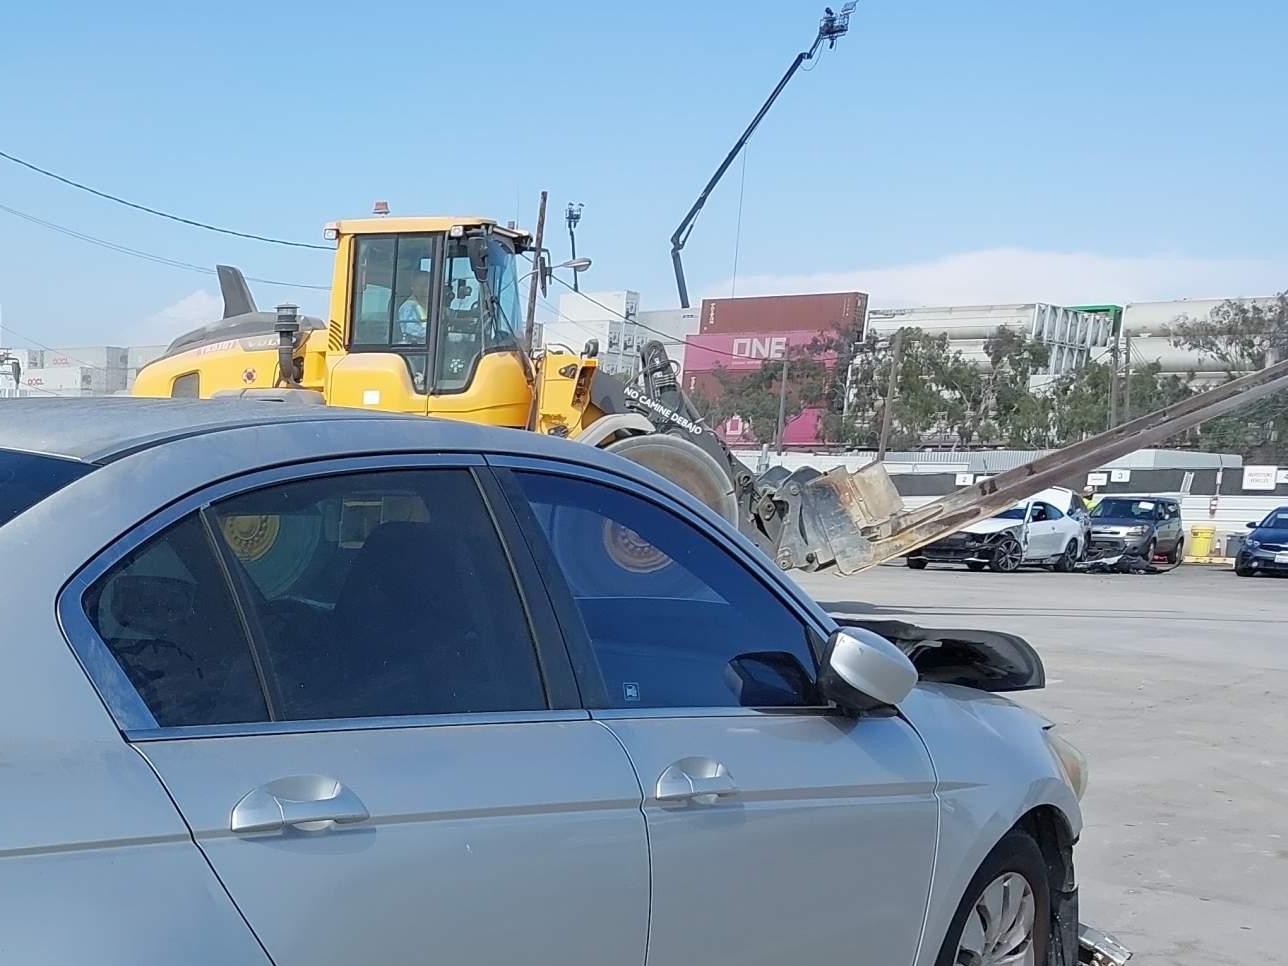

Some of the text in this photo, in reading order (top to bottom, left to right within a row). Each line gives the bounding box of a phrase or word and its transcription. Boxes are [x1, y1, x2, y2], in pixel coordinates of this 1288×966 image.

[733, 337, 786, 359] ONE
[623, 387, 638, 399] NO
[639, 395, 671, 417] CAMINE
[670, 413, 702, 434] DEBAJO
